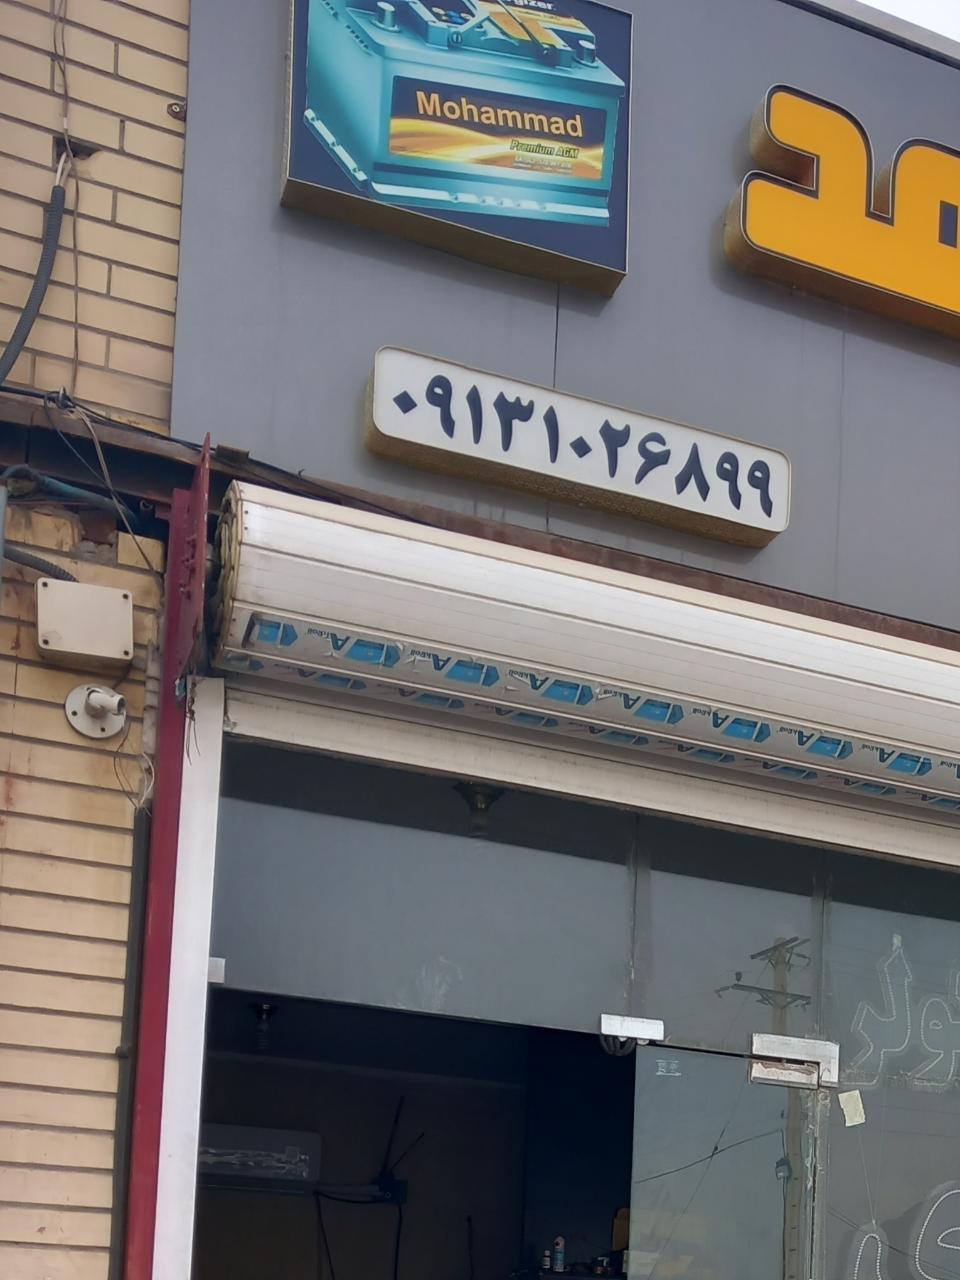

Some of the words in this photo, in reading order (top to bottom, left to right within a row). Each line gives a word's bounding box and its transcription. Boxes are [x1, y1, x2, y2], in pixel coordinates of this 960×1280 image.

[415, 90, 584, 138] Mohammad
[510, 139, 555, 157] Premium
[555, 145, 579, 159] AGM
[393, 374, 773, 518] ۰۹۱۳۱۰۲۶۸۹۹
